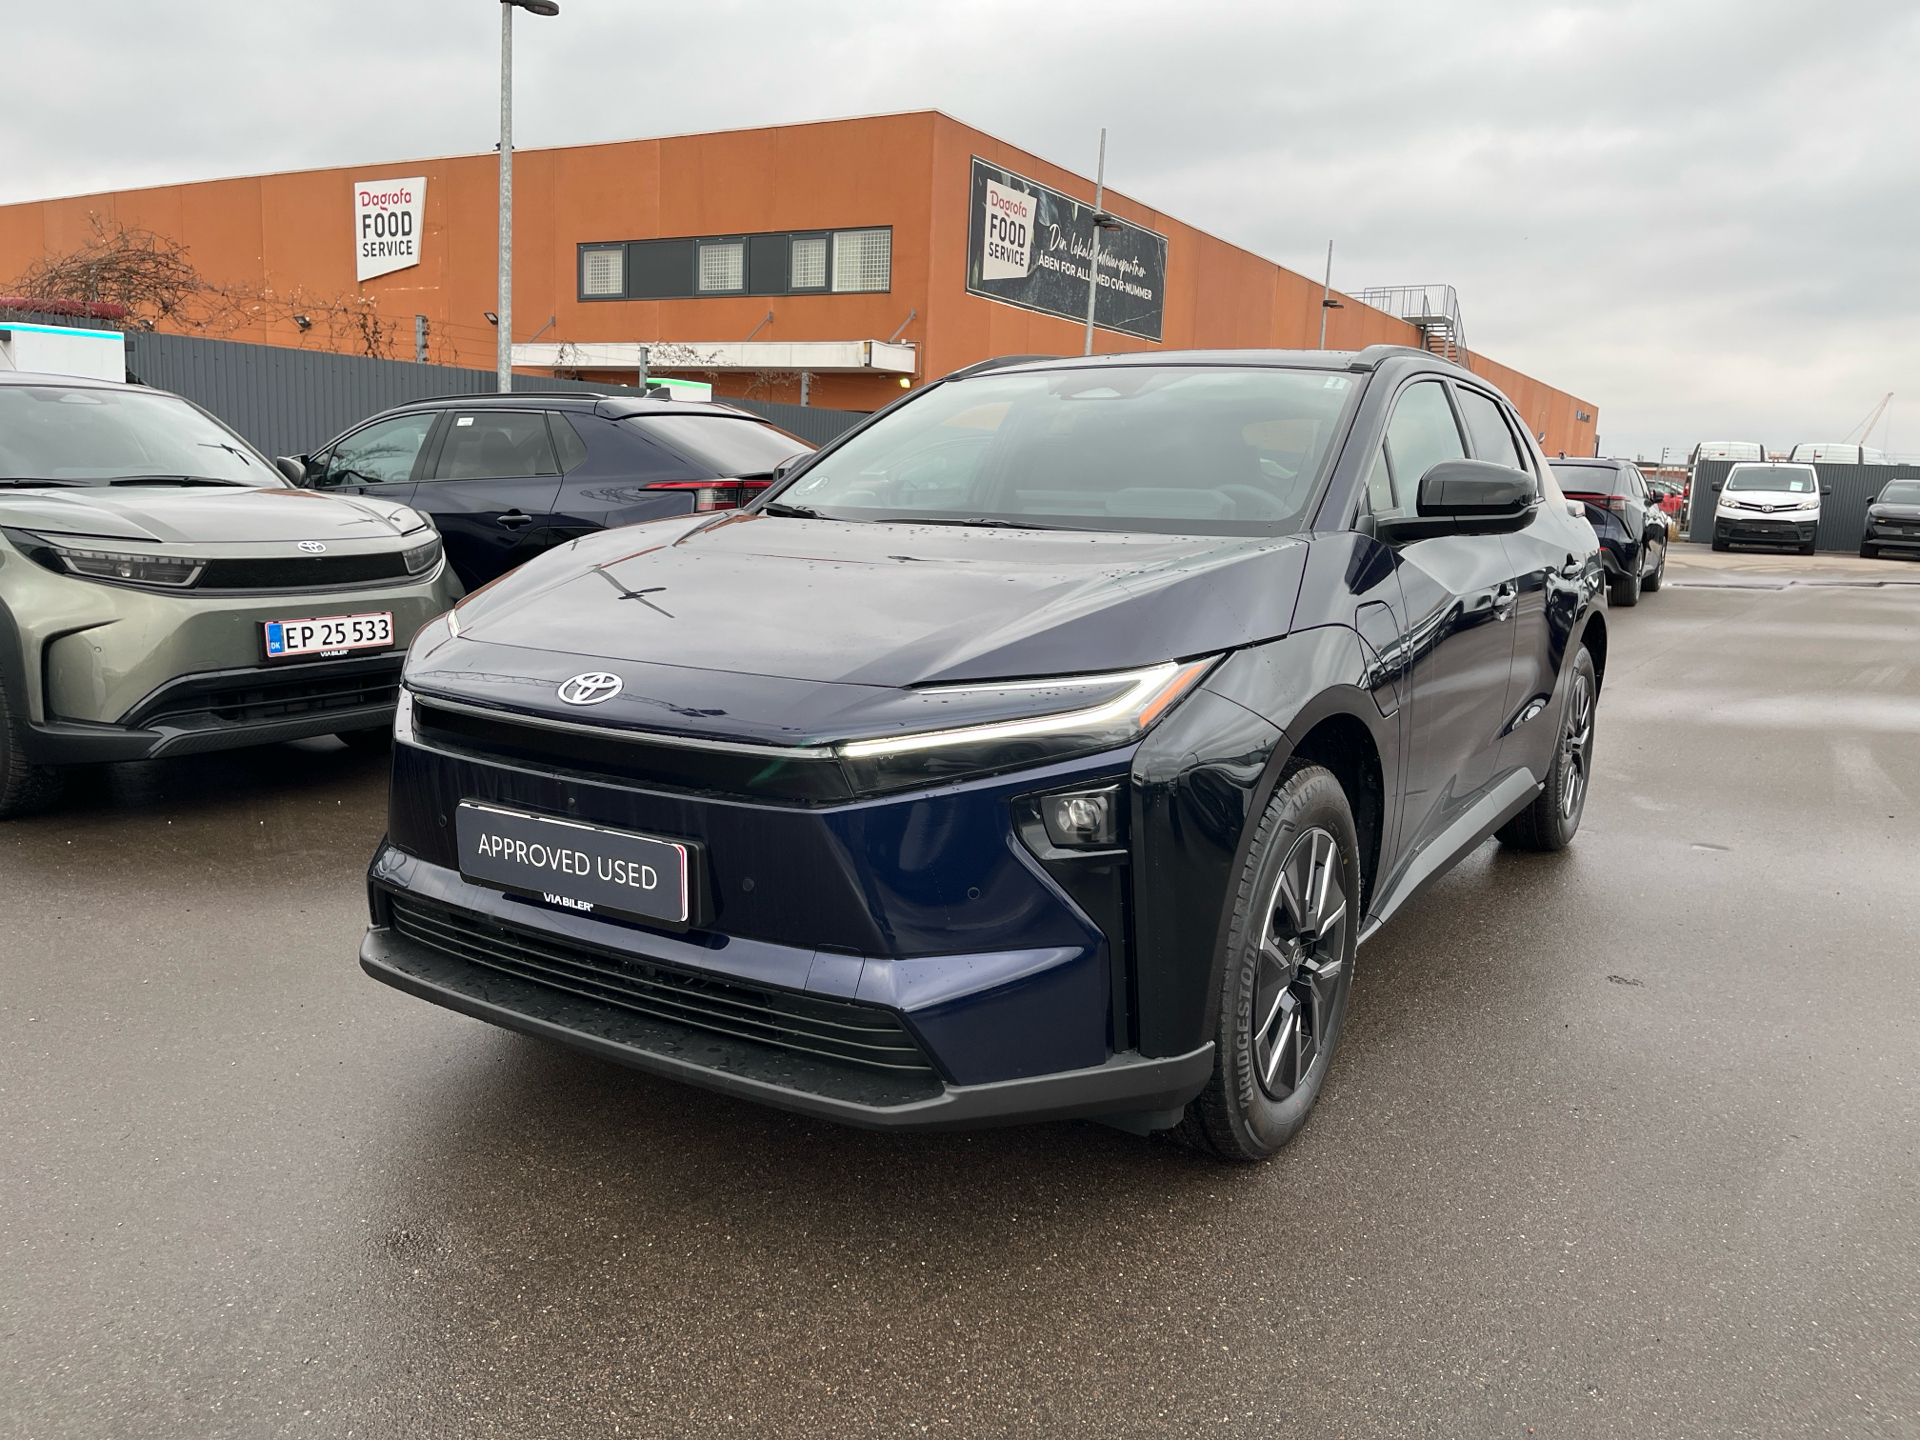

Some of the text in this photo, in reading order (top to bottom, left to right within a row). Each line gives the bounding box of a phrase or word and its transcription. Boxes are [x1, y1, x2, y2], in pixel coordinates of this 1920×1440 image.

[359, 187, 412, 211] Dagrofa
[989, 190, 1027, 218] Dagrofa
[362, 211, 412, 239] FOOD
[990, 213, 1026, 248] FOOD
[1049, 223, 1067, 251] Din
[362, 240, 413, 257] SERVICE
[988, 241, 1025, 267] SERVICE
[1038, 249, 1060, 271] ÅBEN
[1061, 261, 1076, 276] FOR
[1077, 266, 1092, 281] ALL
[1111, 277, 1152, 301] CVR-NUMMER
[270, 642, 280, 650] DK
[286, 619, 389, 649] EP 25 533
[478, 833, 658, 890] APPROVED USED
